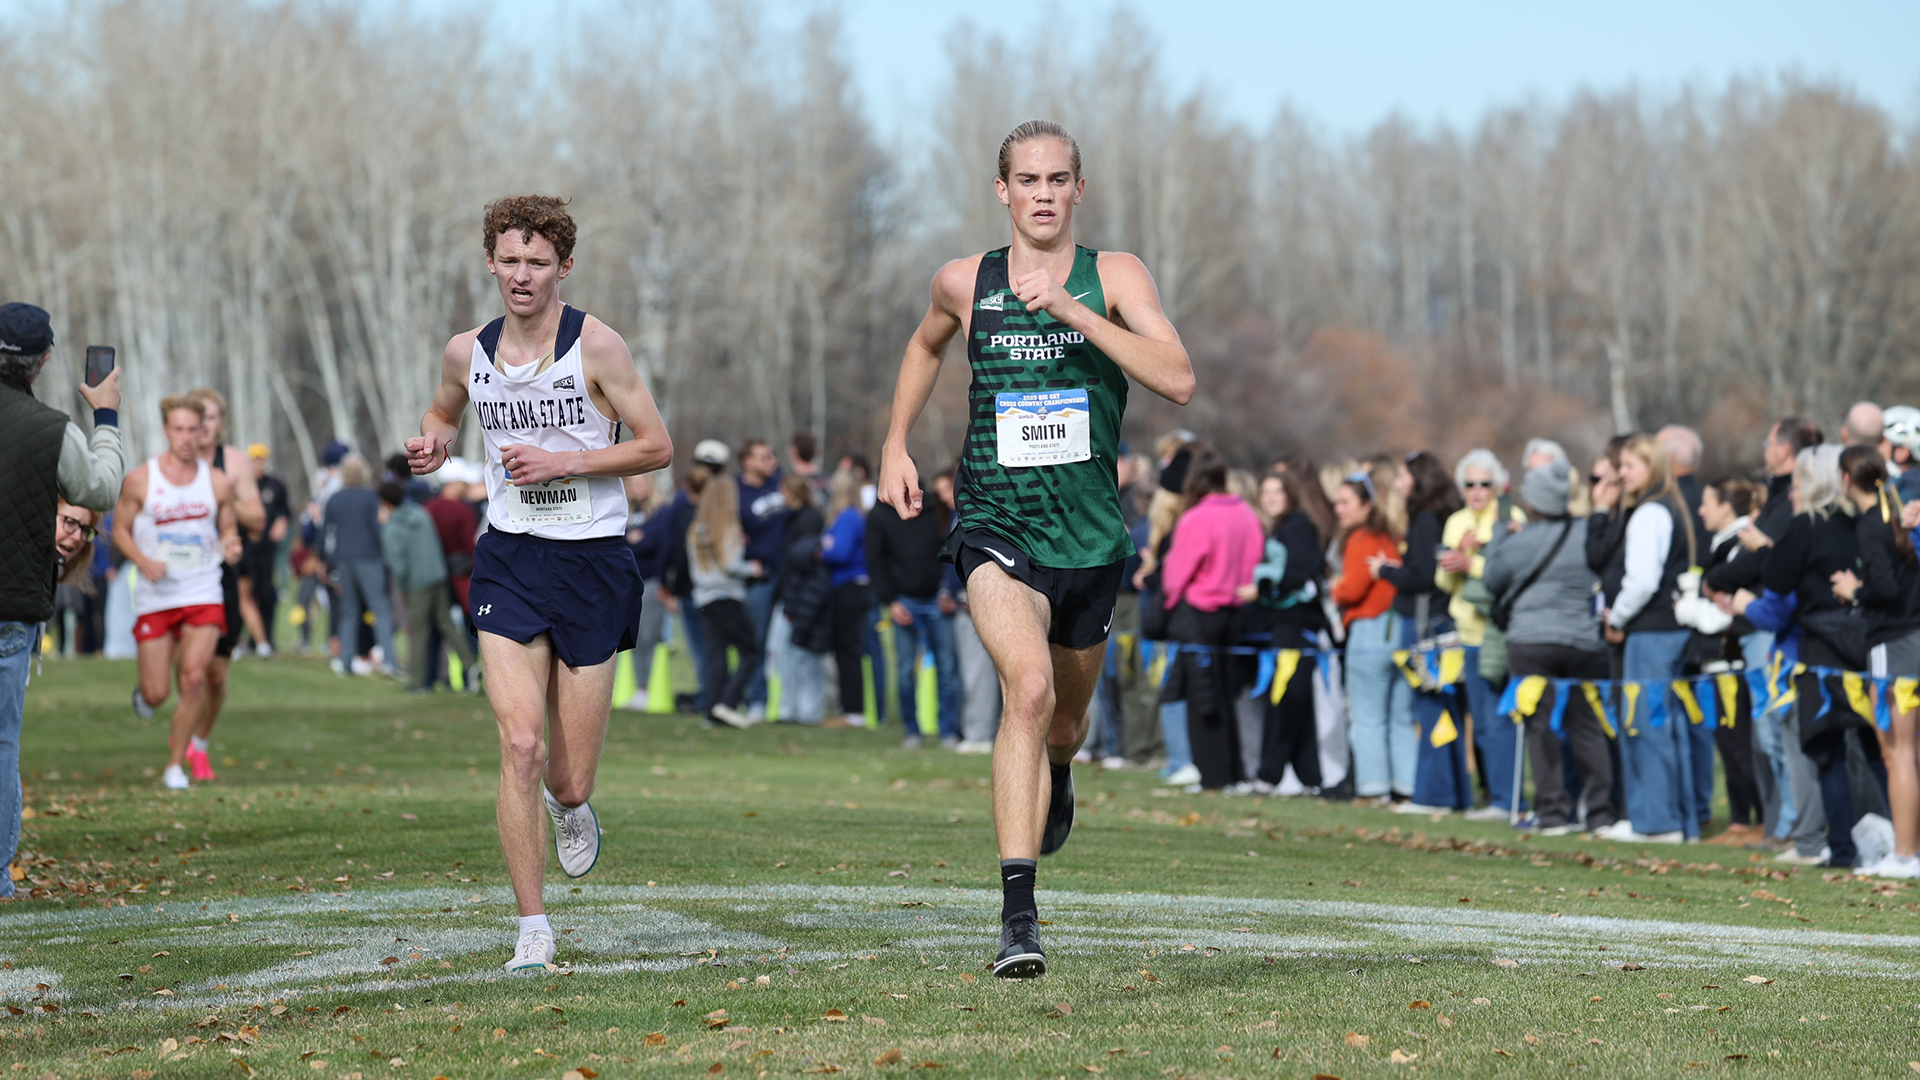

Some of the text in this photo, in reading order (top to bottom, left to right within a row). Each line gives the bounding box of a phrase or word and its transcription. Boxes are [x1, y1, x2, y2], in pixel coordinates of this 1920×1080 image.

[990, 331, 1085, 348] PORTLAND
[1010, 346, 1065, 360] STATE
[1043, 397, 1086, 406] CHAMPIONSHIP
[474, 396, 585, 430] MONTANA STATE
[1021, 423, 1066, 441] SMITH
[520, 488, 577, 505] NEWMAN
